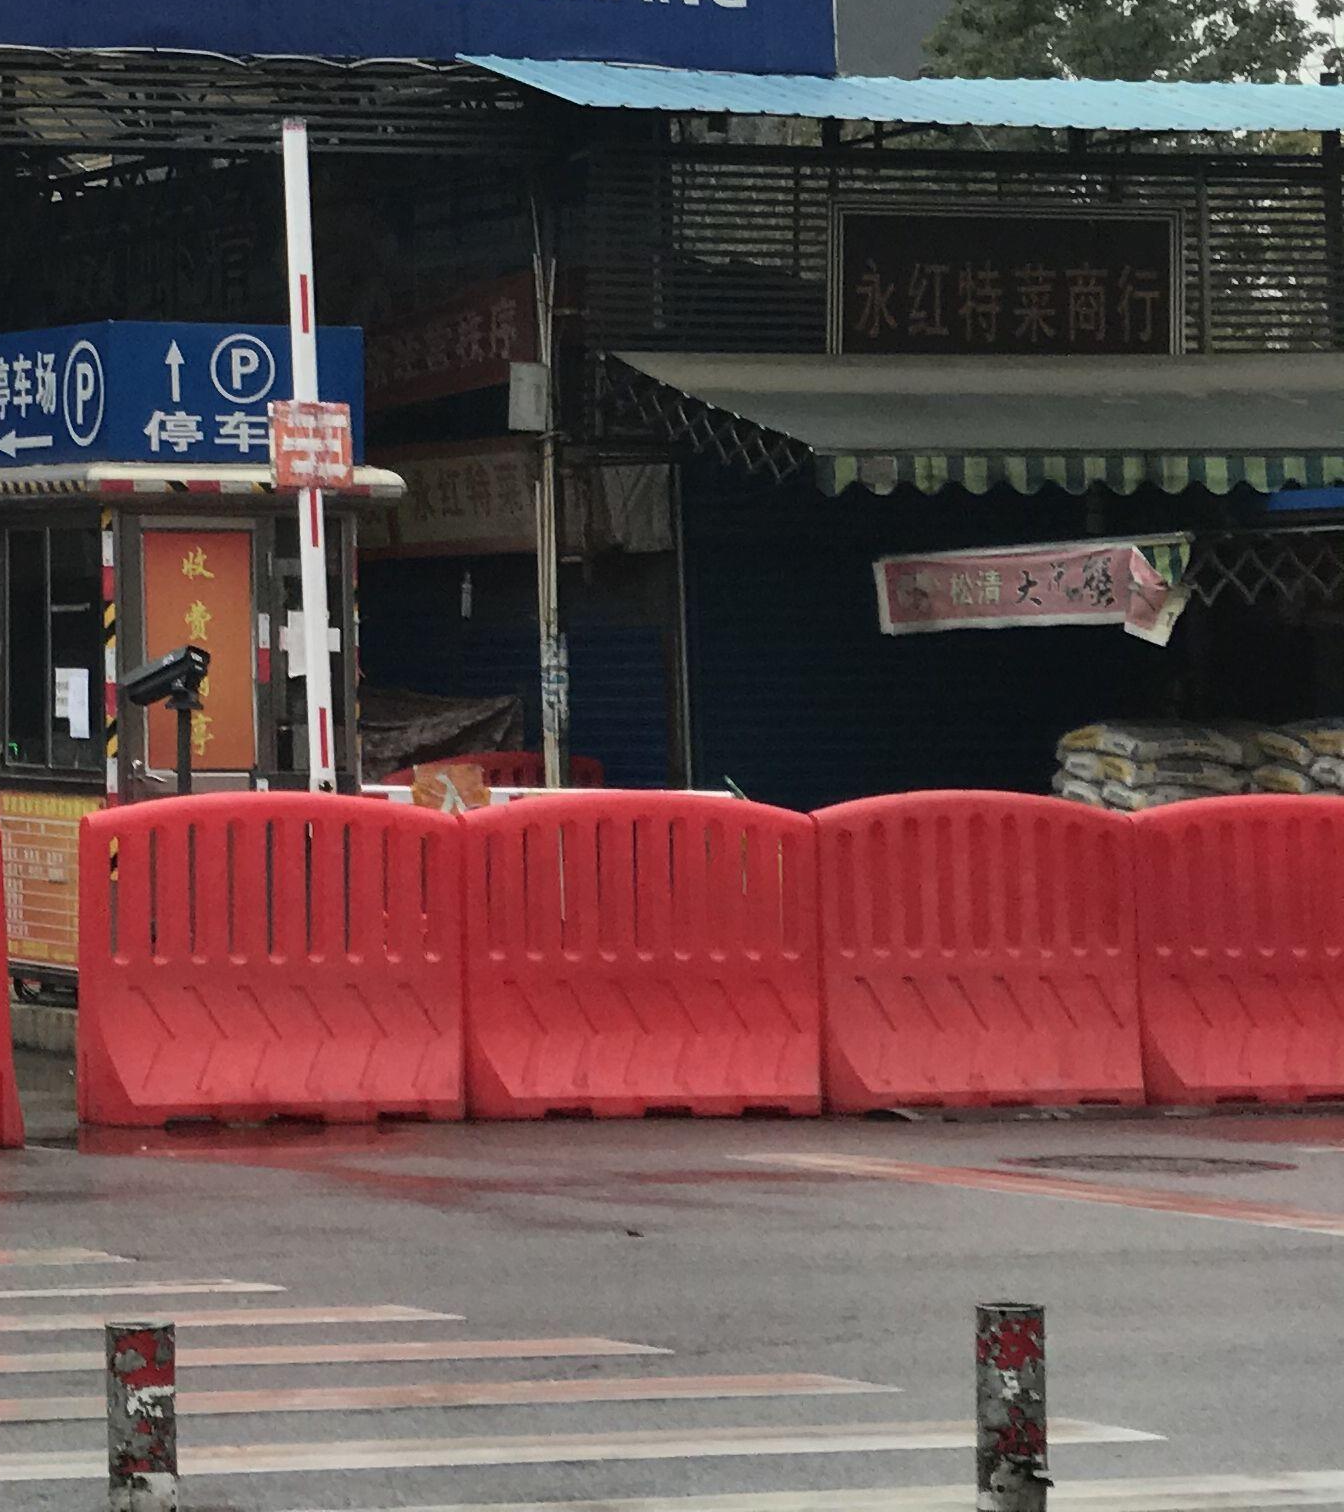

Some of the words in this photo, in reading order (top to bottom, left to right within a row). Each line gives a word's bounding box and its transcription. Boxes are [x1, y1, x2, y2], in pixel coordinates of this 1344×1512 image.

[855, 260, 1163, 344] 永红特菜商行
[181, 546, 214, 756] 收费亭
